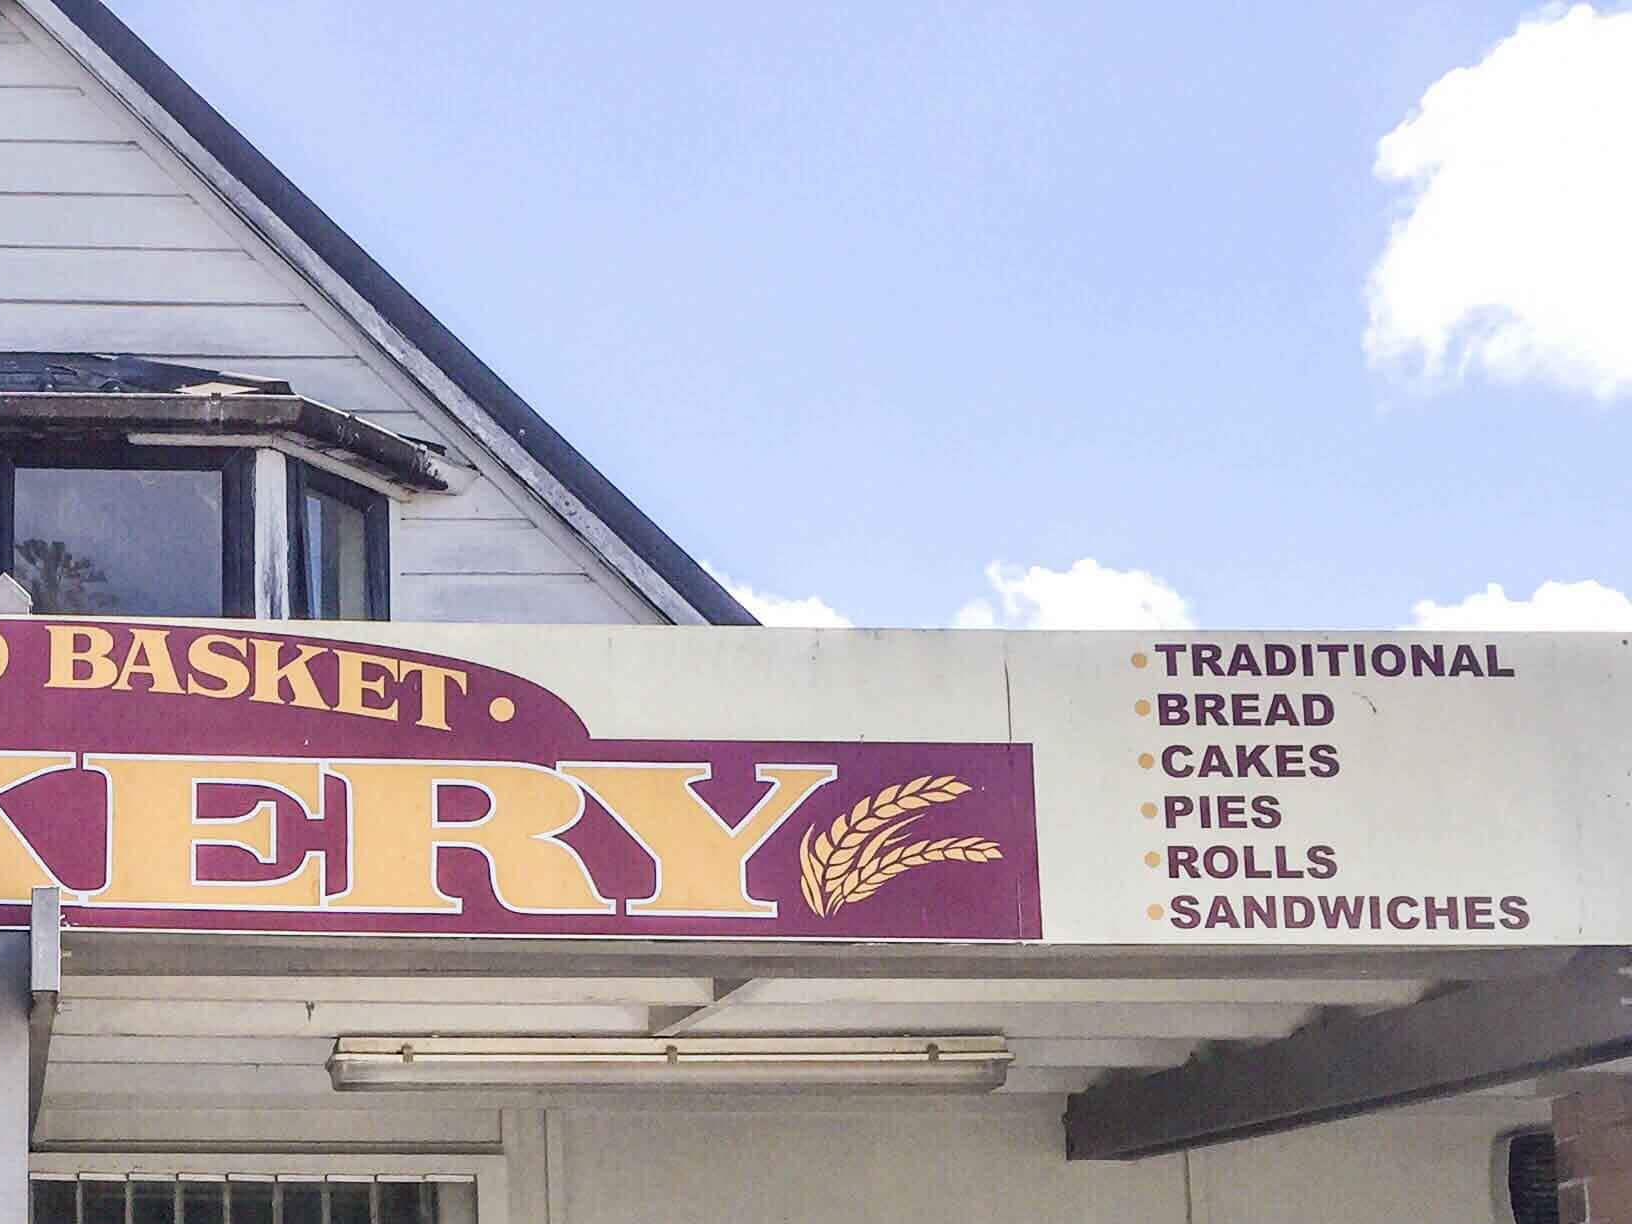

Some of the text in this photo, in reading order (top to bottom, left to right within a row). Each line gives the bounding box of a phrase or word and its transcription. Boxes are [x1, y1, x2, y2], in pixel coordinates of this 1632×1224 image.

[1155, 643, 1515, 677] TRADITIONAL
[44, 625, 467, 731] BASKET
[1157, 693, 1335, 726] BREAD
[1161, 744, 1340, 778] CAKES
[1164, 795, 1282, 828] PIES
[1167, 846, 1337, 879] ROLLS
[1170, 895, 1530, 929] SANDWICHES
